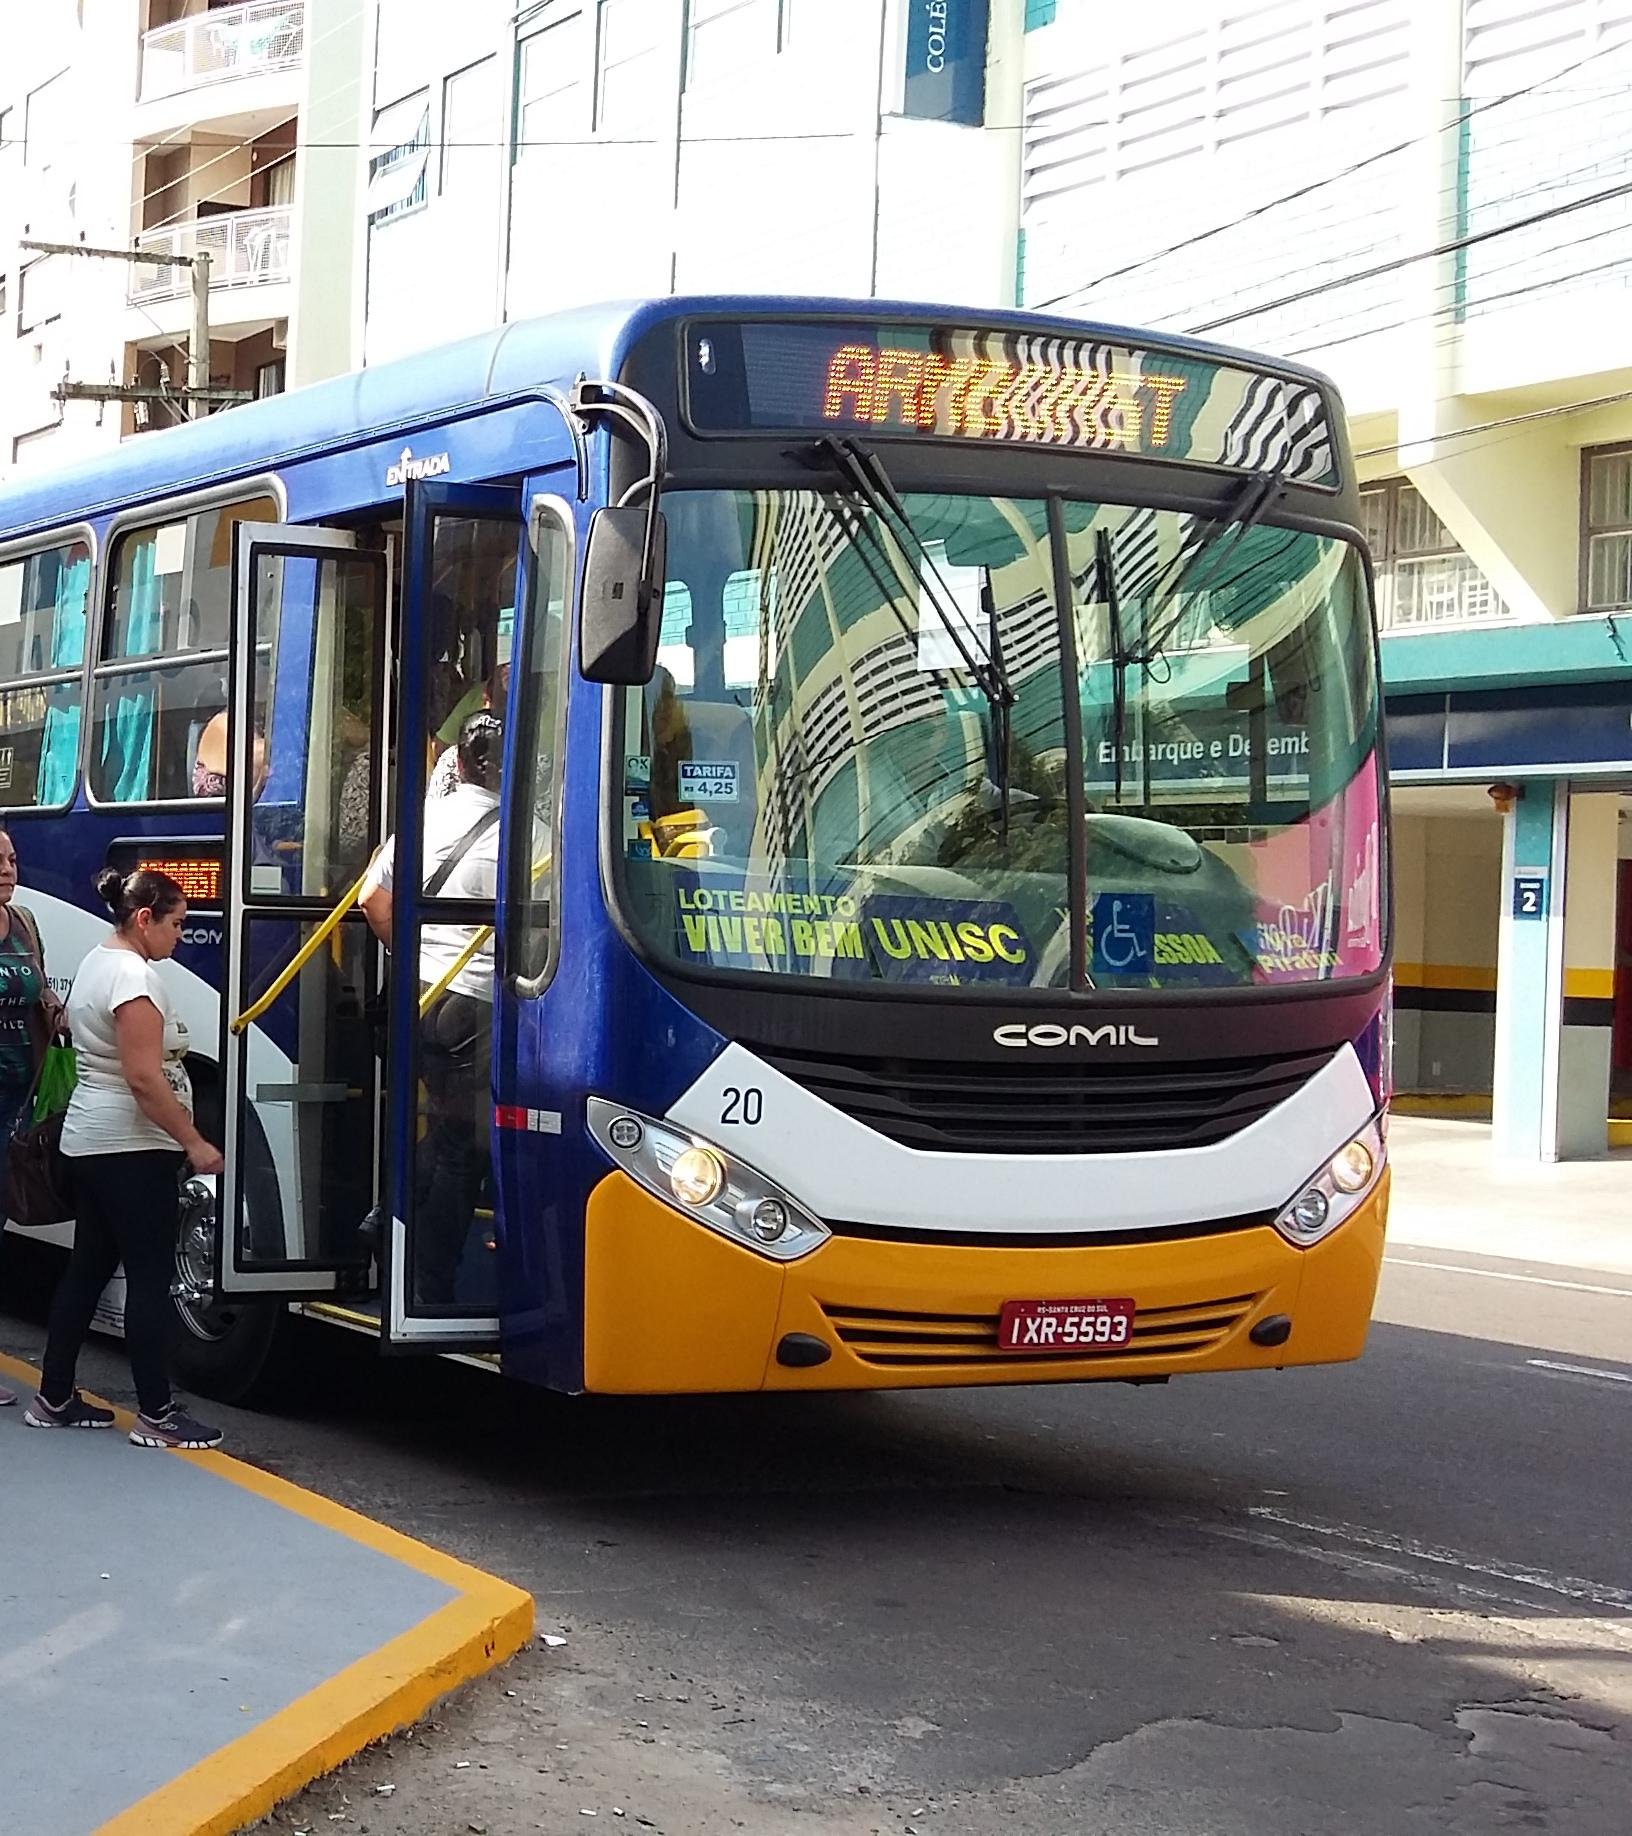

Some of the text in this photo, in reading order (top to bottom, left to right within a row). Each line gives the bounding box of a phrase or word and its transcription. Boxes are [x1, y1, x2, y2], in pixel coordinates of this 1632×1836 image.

[926, 0, 947, 73] COLÉ
[386, 451, 449, 487] ENTRADA
[1210, 740, 1222, 757] e
[1229, 731, 1309, 757] Deemb
[684, 766, 733, 777] TARIFA
[698, 781, 734, 797] 4,25
[679, 889, 856, 917] LOTEAMENTO
[1522, 891, 1536, 911] 2
[682, 915, 865, 959] VIVER BEM
[871, 917, 1027, 964] UNISC
[0, 997, 26, 1006] THE
[993, 1024, 1158, 1047] COMIL
[721, 1087, 763, 1125] 20
